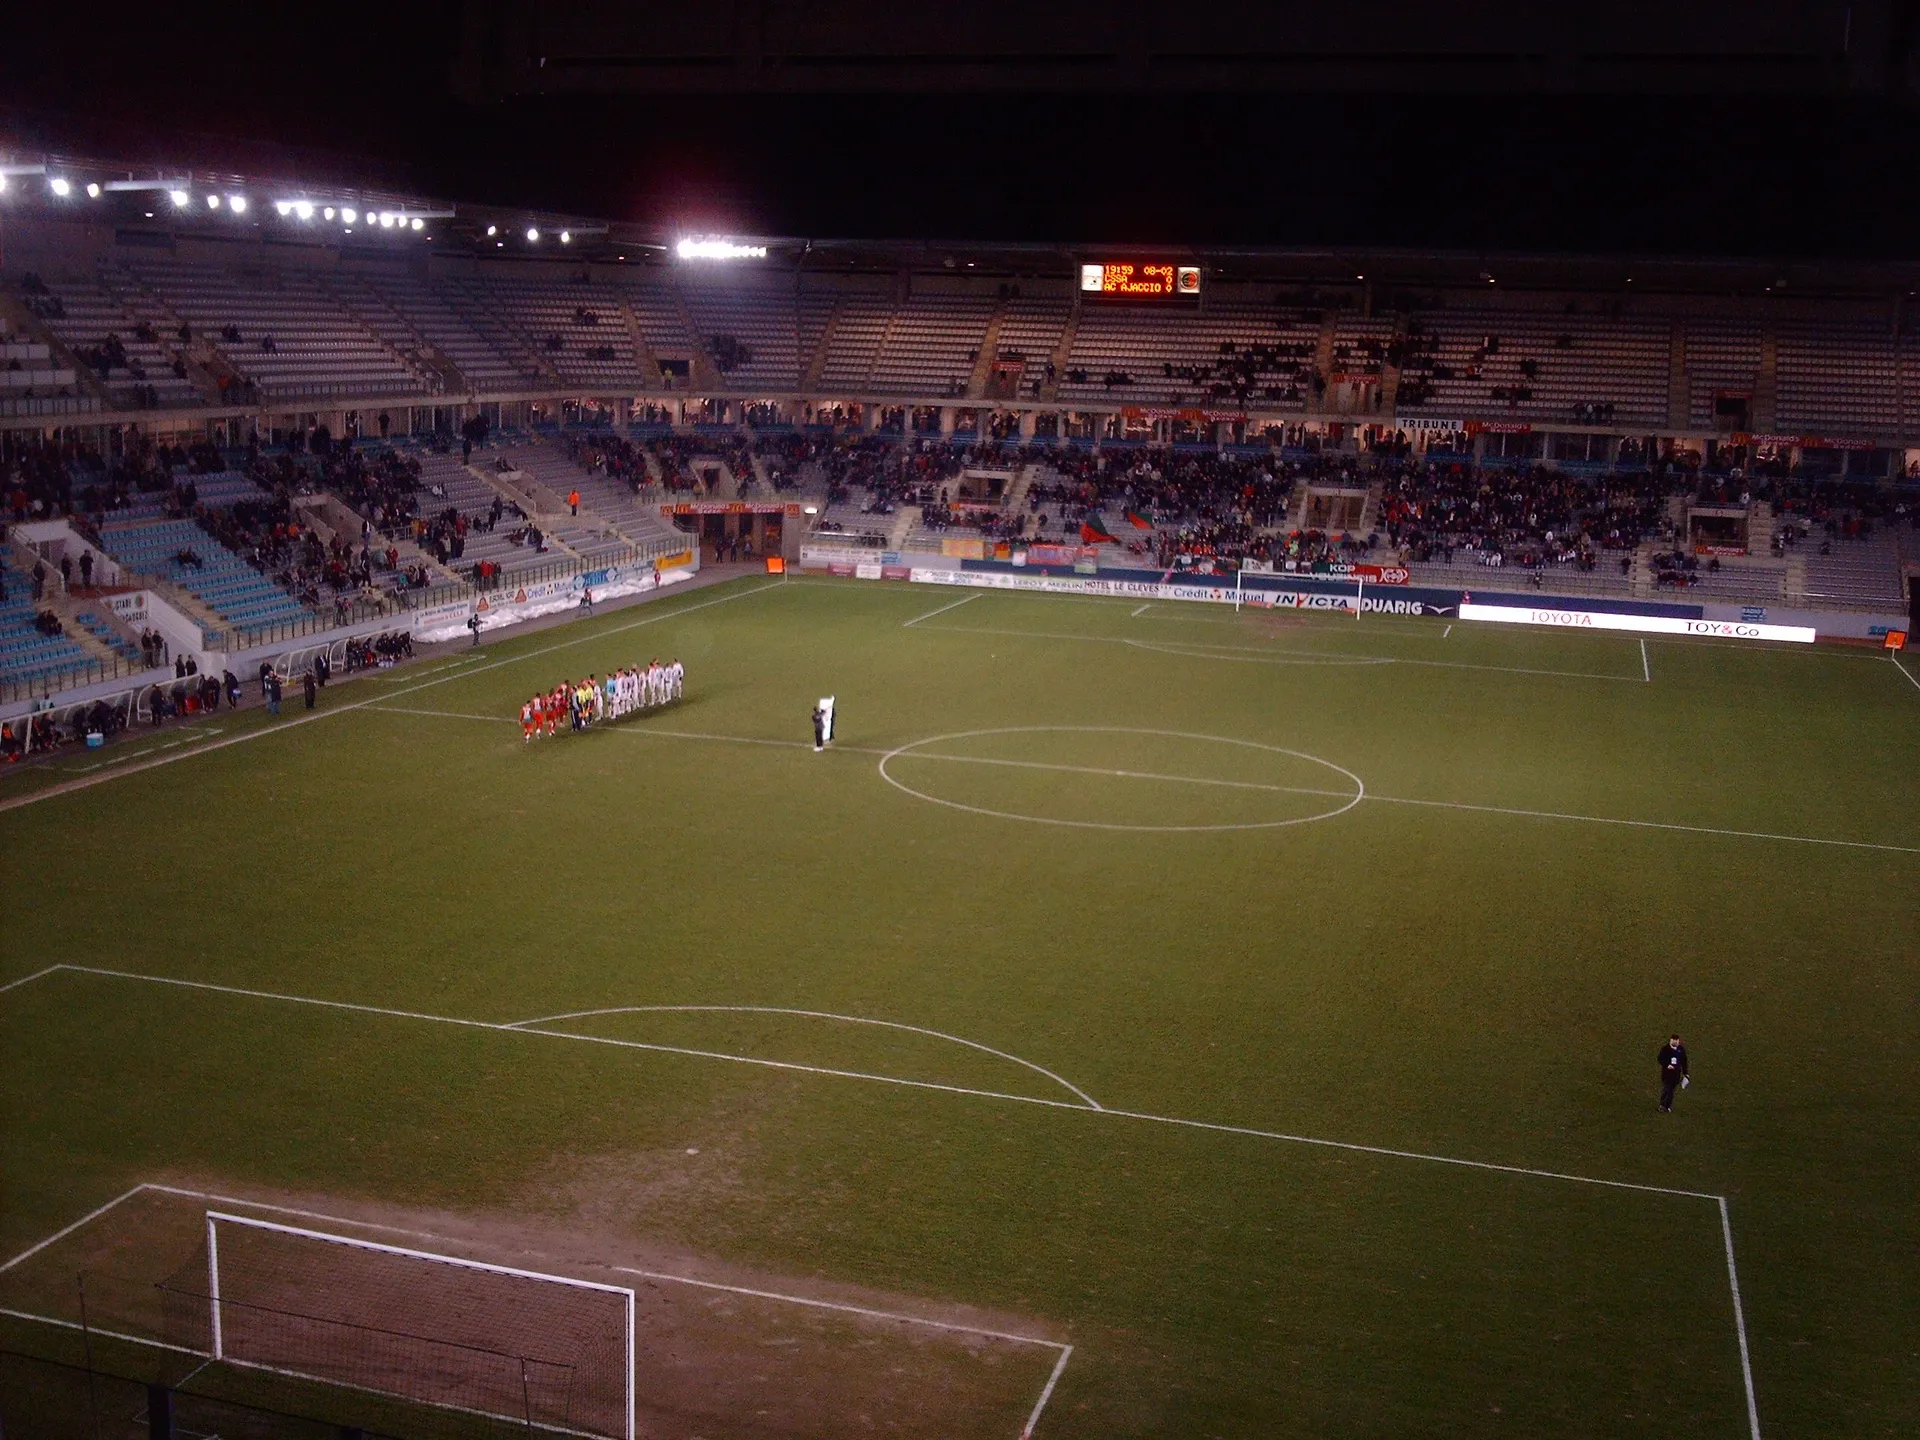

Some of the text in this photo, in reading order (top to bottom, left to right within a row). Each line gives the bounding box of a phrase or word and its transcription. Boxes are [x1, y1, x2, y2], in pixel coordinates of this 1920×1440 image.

[1105, 265, 1173, 275] 19:59 08-02
[1104, 275, 1128, 283] CSSA
[1121, 284, 1161, 292] AJACCIO
[1402, 419, 1457, 430] TRIBUNE
[1329, 563, 1355, 573] KOP
[1047, 581, 1083, 589] MERLIN
[1084, 581, 1110, 590] HOTEL
[1174, 587, 1208, 599] Crédit
[1276, 593, 1348, 608] INVICTA
[1362, 598, 1423, 615] DUARIG
[1531, 611, 1592, 626] TOYOTA
